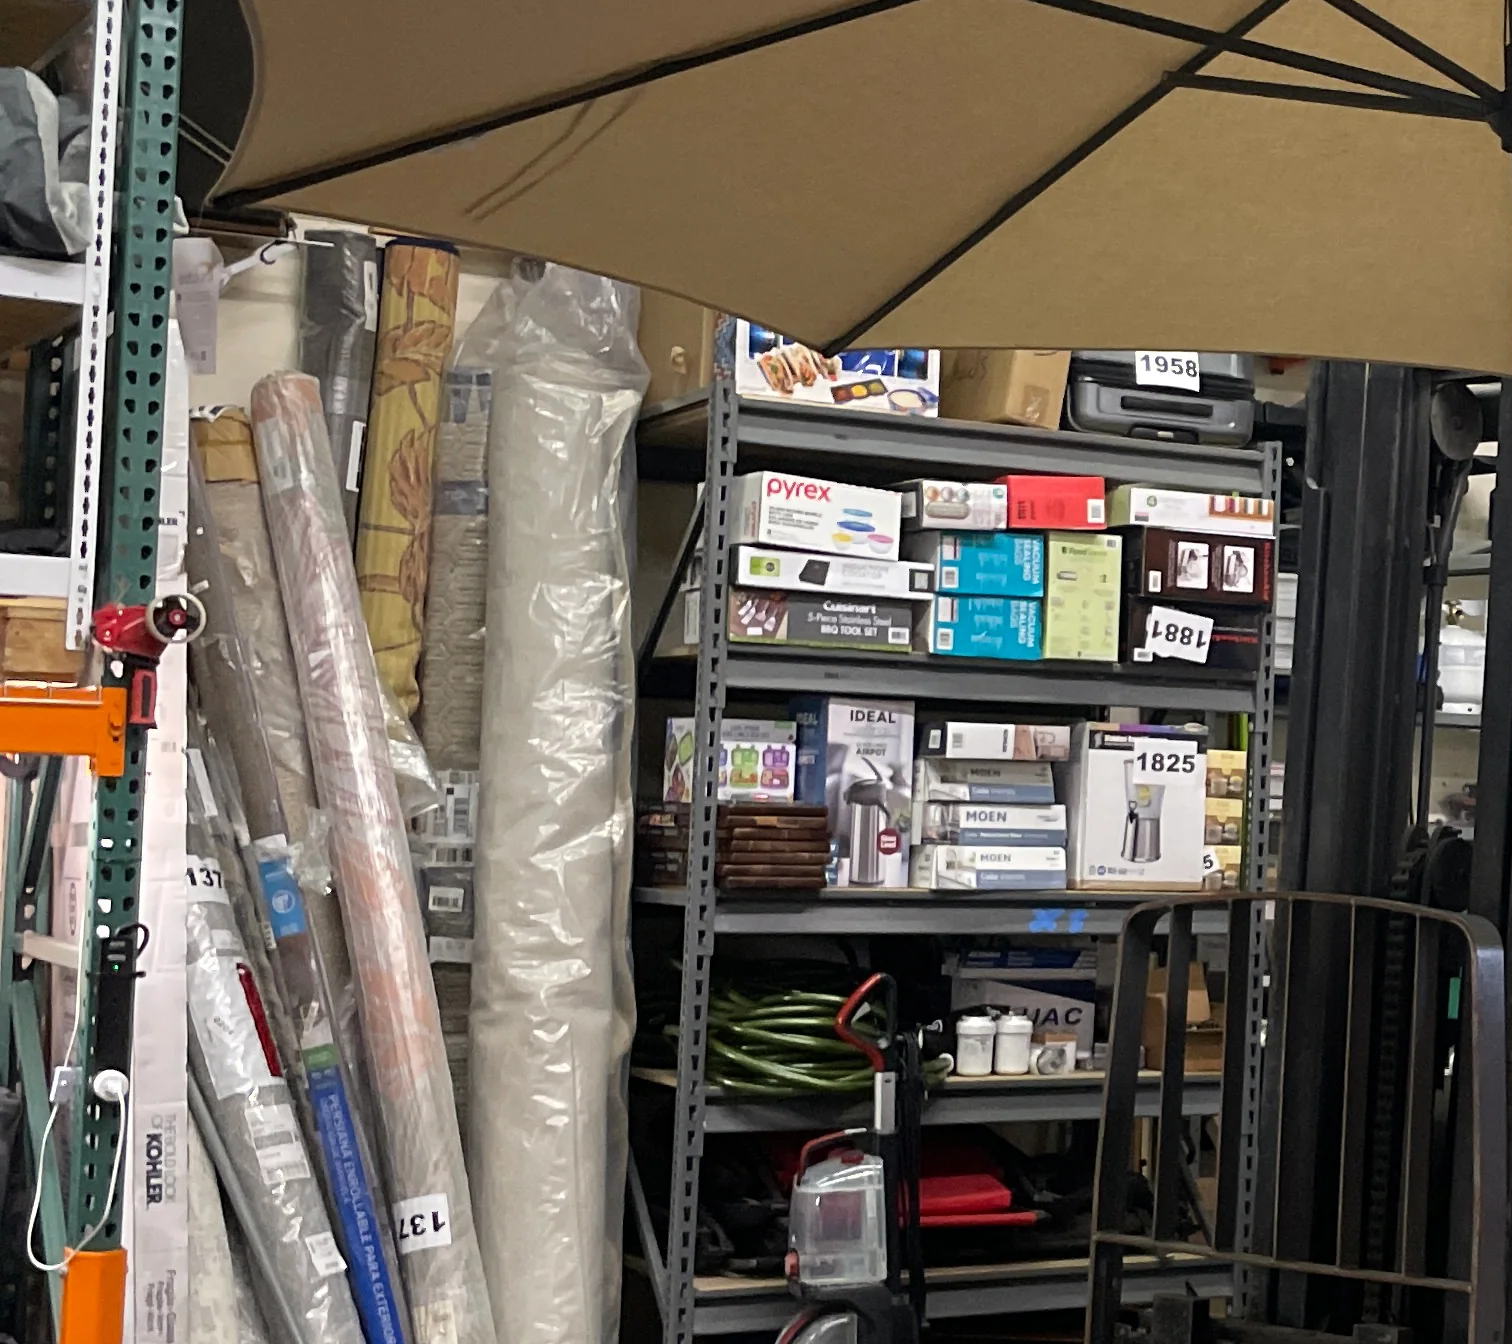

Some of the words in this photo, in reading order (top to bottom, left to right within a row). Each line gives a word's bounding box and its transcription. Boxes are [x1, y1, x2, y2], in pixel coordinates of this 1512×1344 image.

[1139, 353, 1198, 378] 1958
[766, 477, 832, 503] pyrex
[1022, 538, 1032, 582] SEALING
[1031, 538, 1041, 585] VACUUM
[820, 624, 839, 635] BBQ
[840, 625, 862, 636] TOOL
[863, 626, 878, 638] SET
[1018, 600, 1028, 645] SEALING
[1026, 601, 1037, 649] VACUUM
[1151, 620, 1208, 649] 1881
[850, 709, 897, 724] IDEAL
[855, 747, 887, 757] AIRPOT
[1136, 752, 1196, 774] 1825
[965, 810, 1008, 823] MOEN
[980, 852, 1012, 863] MOEN
[151, 1113, 164, 1130] OF
[164, 1113, 177, 1136] THE
[164, 1136, 177, 1168] BOLD
[145, 1133, 163, 1206] KOHLER
[164, 1168, 177, 1204] LOOK
[327, 1093, 353, 1158] PERSIANA
[343, 1161, 371, 1244] ENROLLABLE
[363, 1245, 381, 1282] PARA
